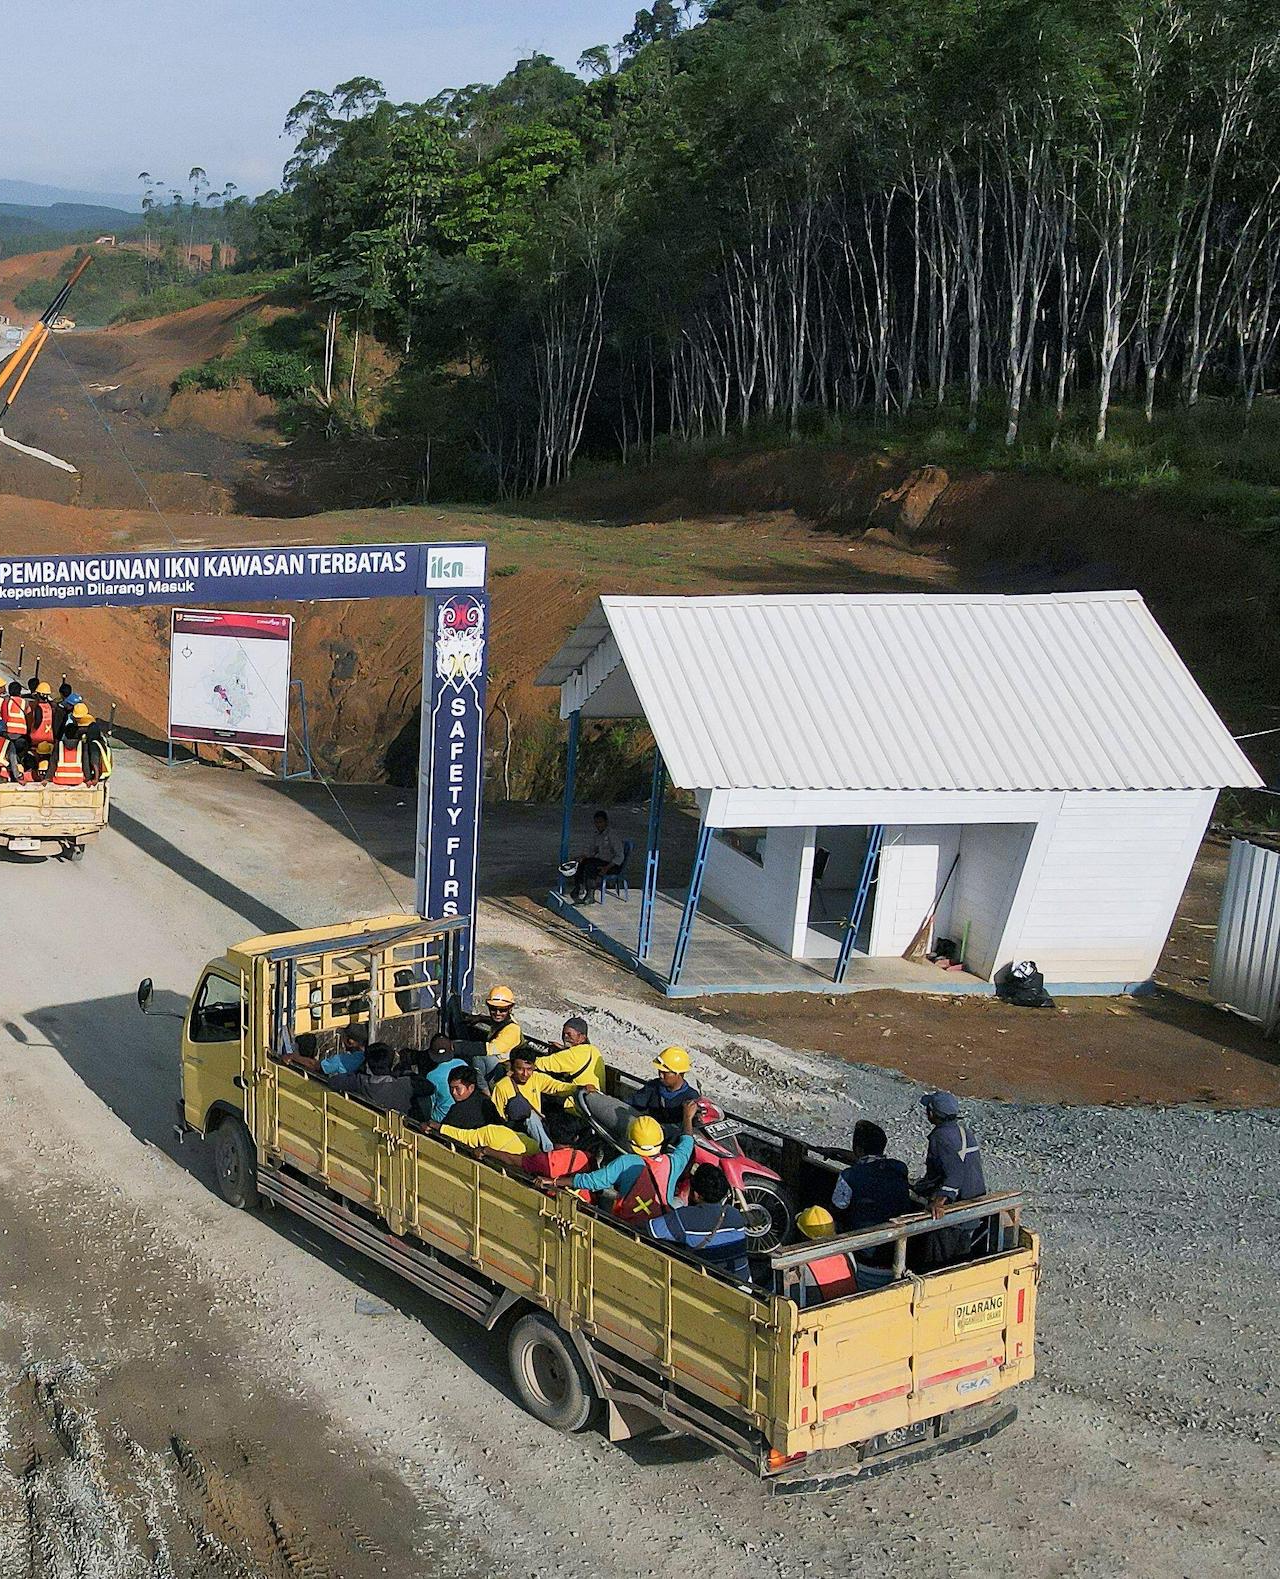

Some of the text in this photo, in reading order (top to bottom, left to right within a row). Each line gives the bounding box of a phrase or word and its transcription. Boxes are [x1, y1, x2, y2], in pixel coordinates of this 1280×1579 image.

[0, 557, 160, 584] PEMBANGUNAN
[164, 556, 199, 579] IKN
[204, 554, 305, 577] KAWASAN
[308, 551, 406, 574] TERBATAS
[431, 556, 463, 578] ikn
[87, 582, 145, 596] Dilarang
[148, 580, 195, 593] Masuk
[443, 698, 466, 917] SAFETY FIRS
[956, 1297, 1002, 1317] DILARANG
